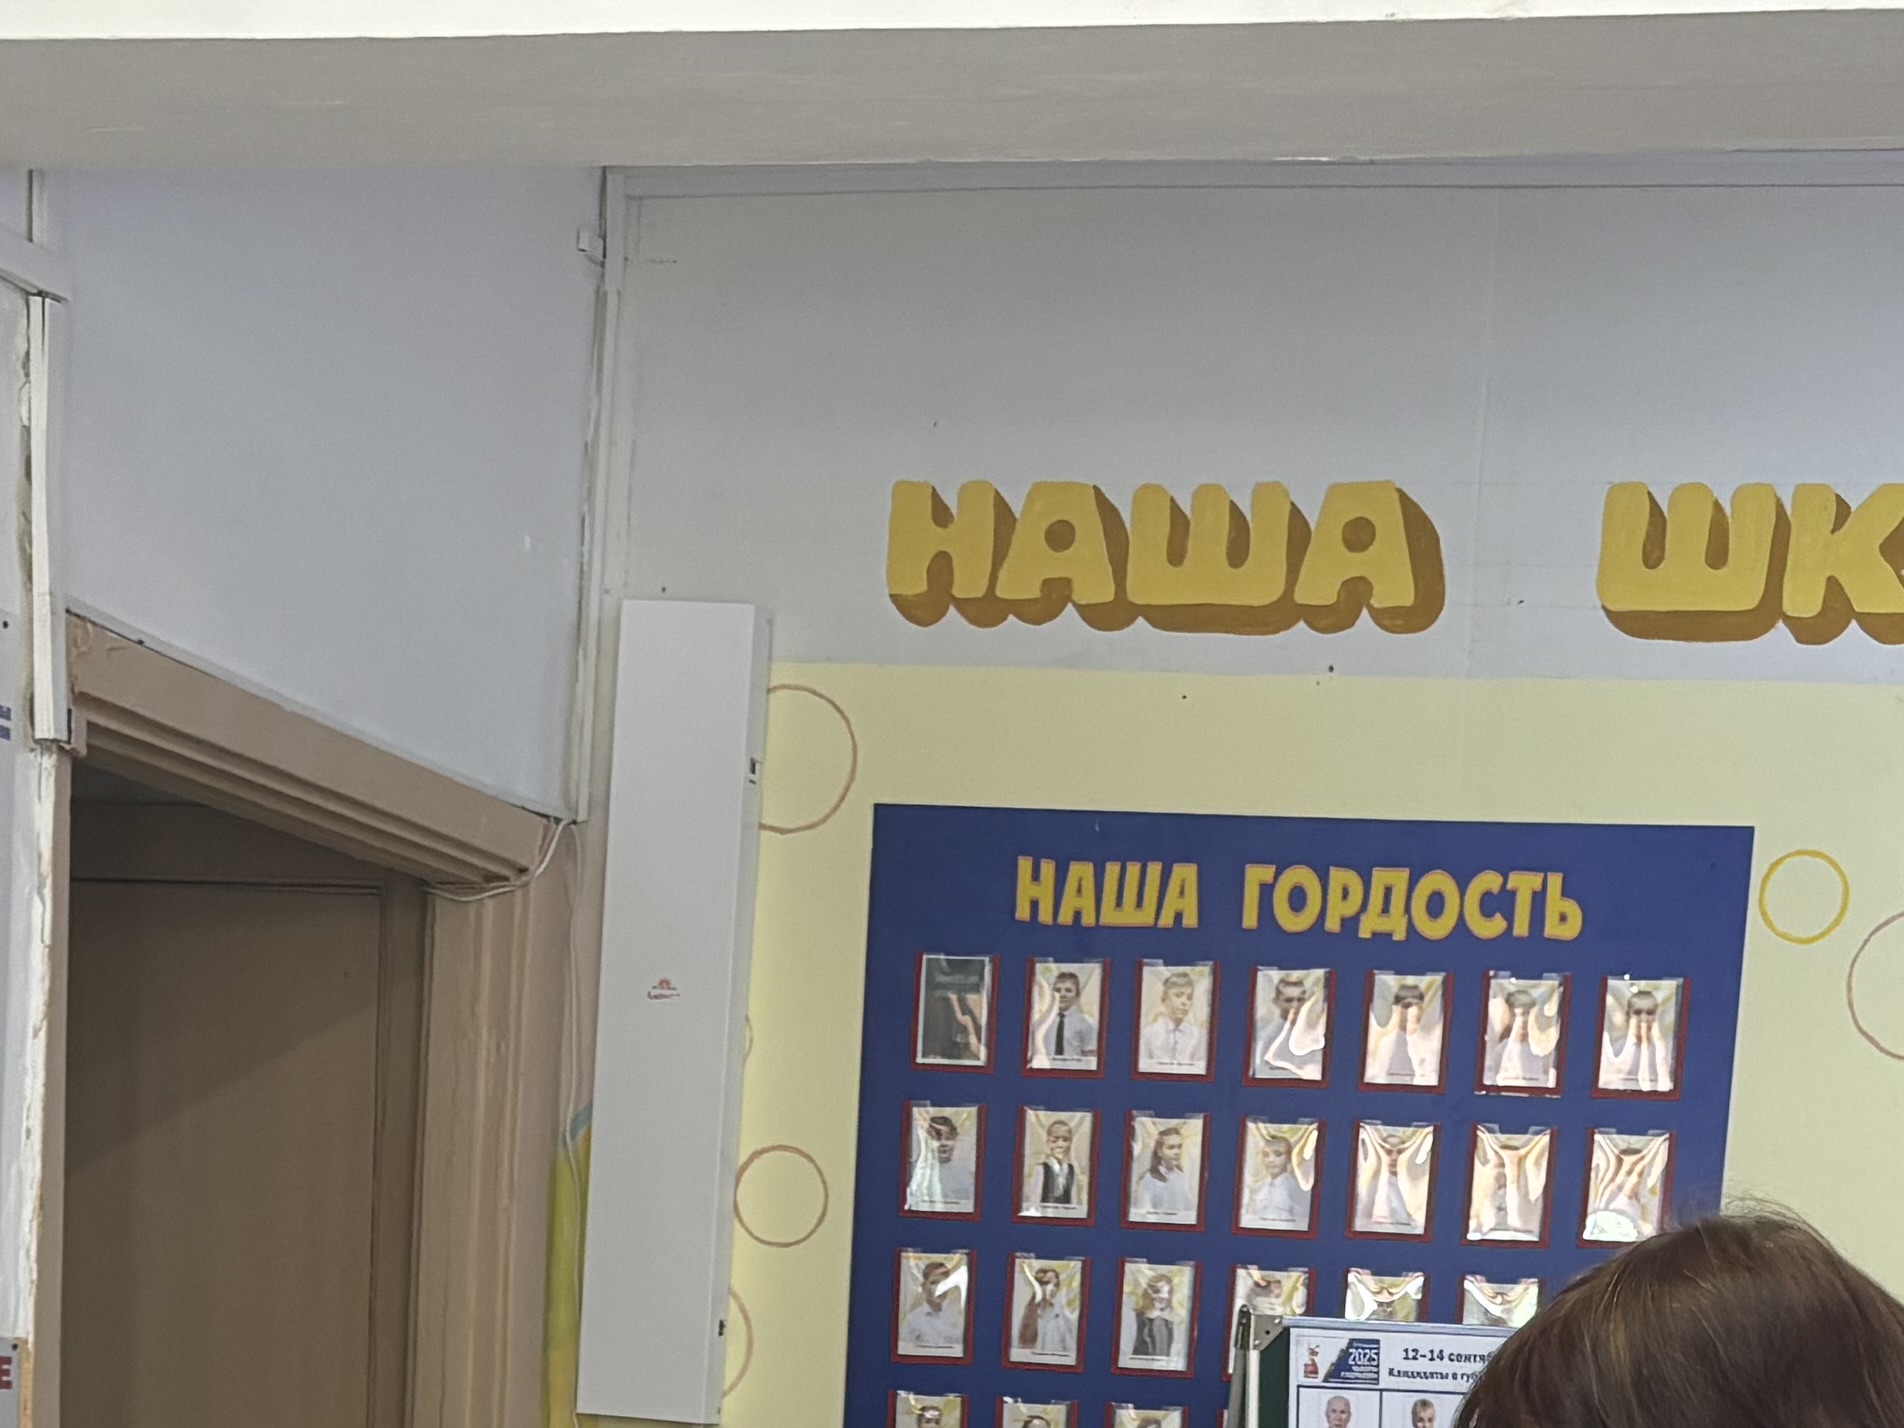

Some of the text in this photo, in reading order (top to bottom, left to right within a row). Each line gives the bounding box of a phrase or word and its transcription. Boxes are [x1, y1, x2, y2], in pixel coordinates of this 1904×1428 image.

[885, 480, 1446, 636] НАША
[1016, 856, 1583, 942] НАША ГОРДОСТЬ
